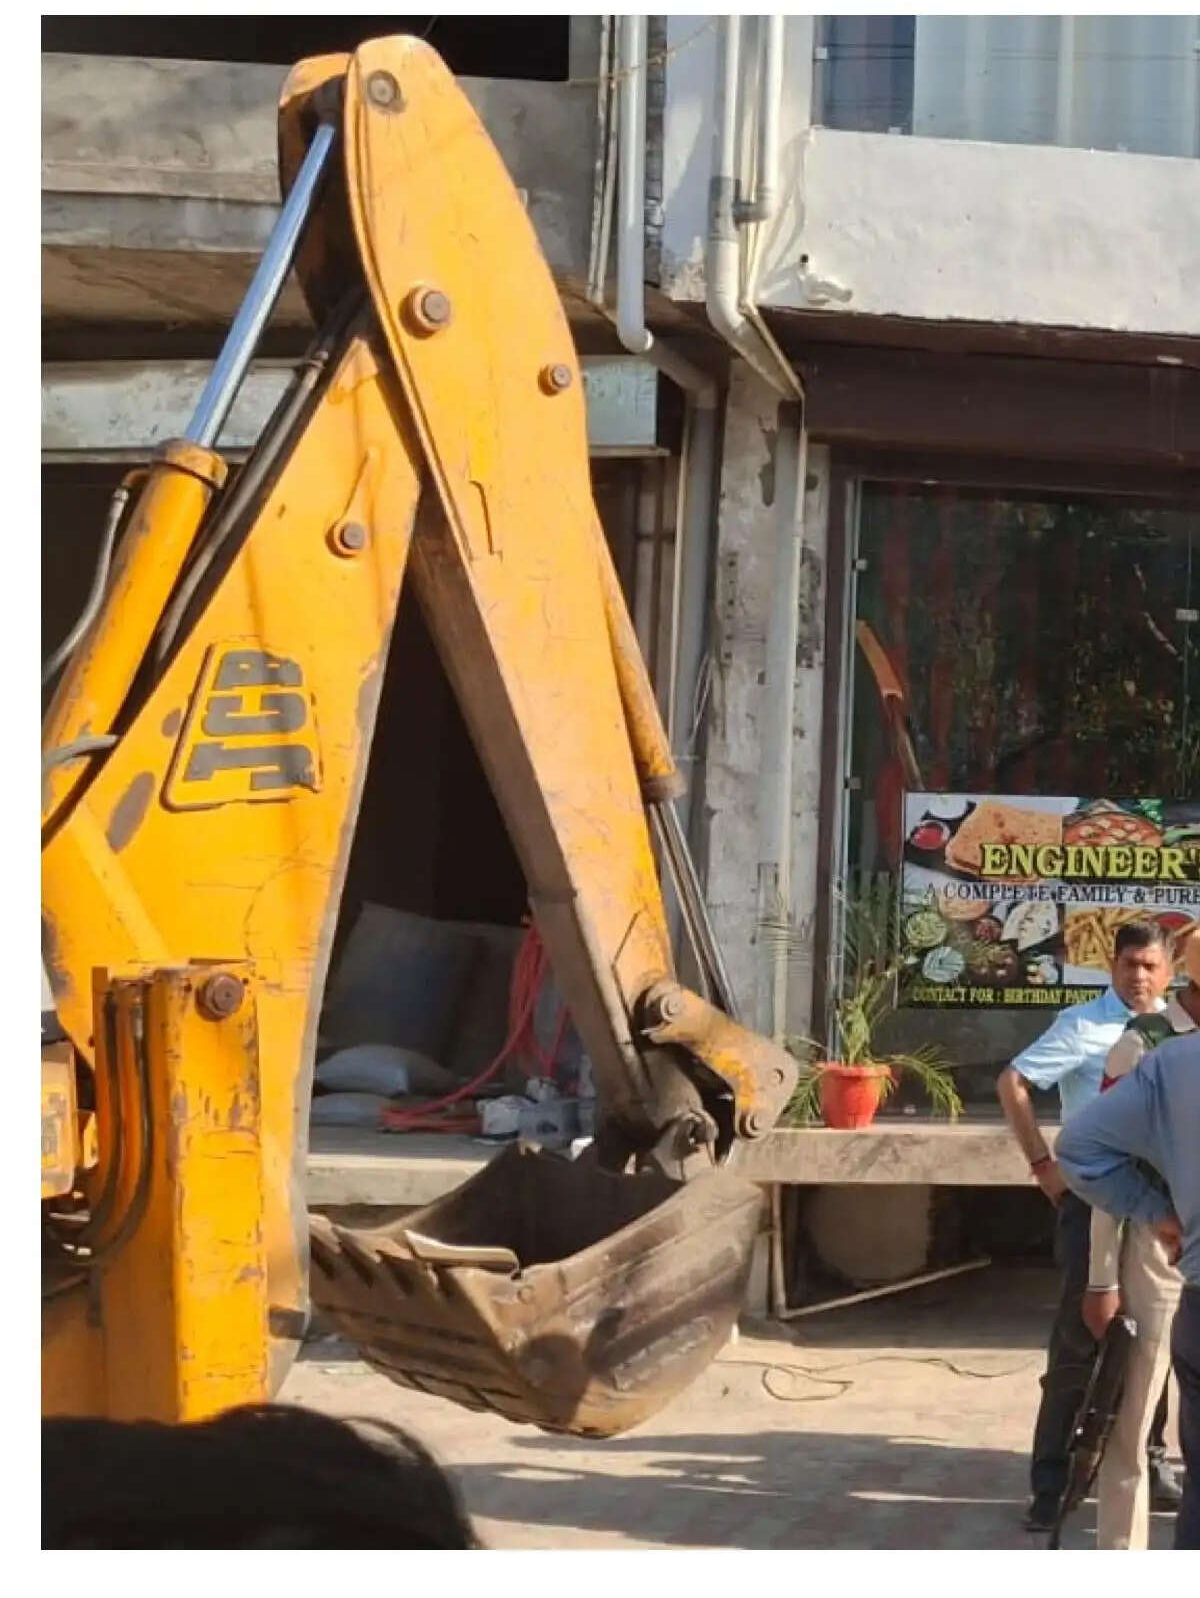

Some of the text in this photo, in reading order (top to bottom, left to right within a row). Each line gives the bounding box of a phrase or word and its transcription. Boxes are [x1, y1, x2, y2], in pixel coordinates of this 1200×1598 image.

[182, 649, 315, 791] JCB
[943, 881, 1049, 901] COMPLETE
[1055, 884, 1127, 902] FAMILY
[1134, 886, 1147, 903] &
[1004, 987, 1062, 1003] BIRTHDAY
